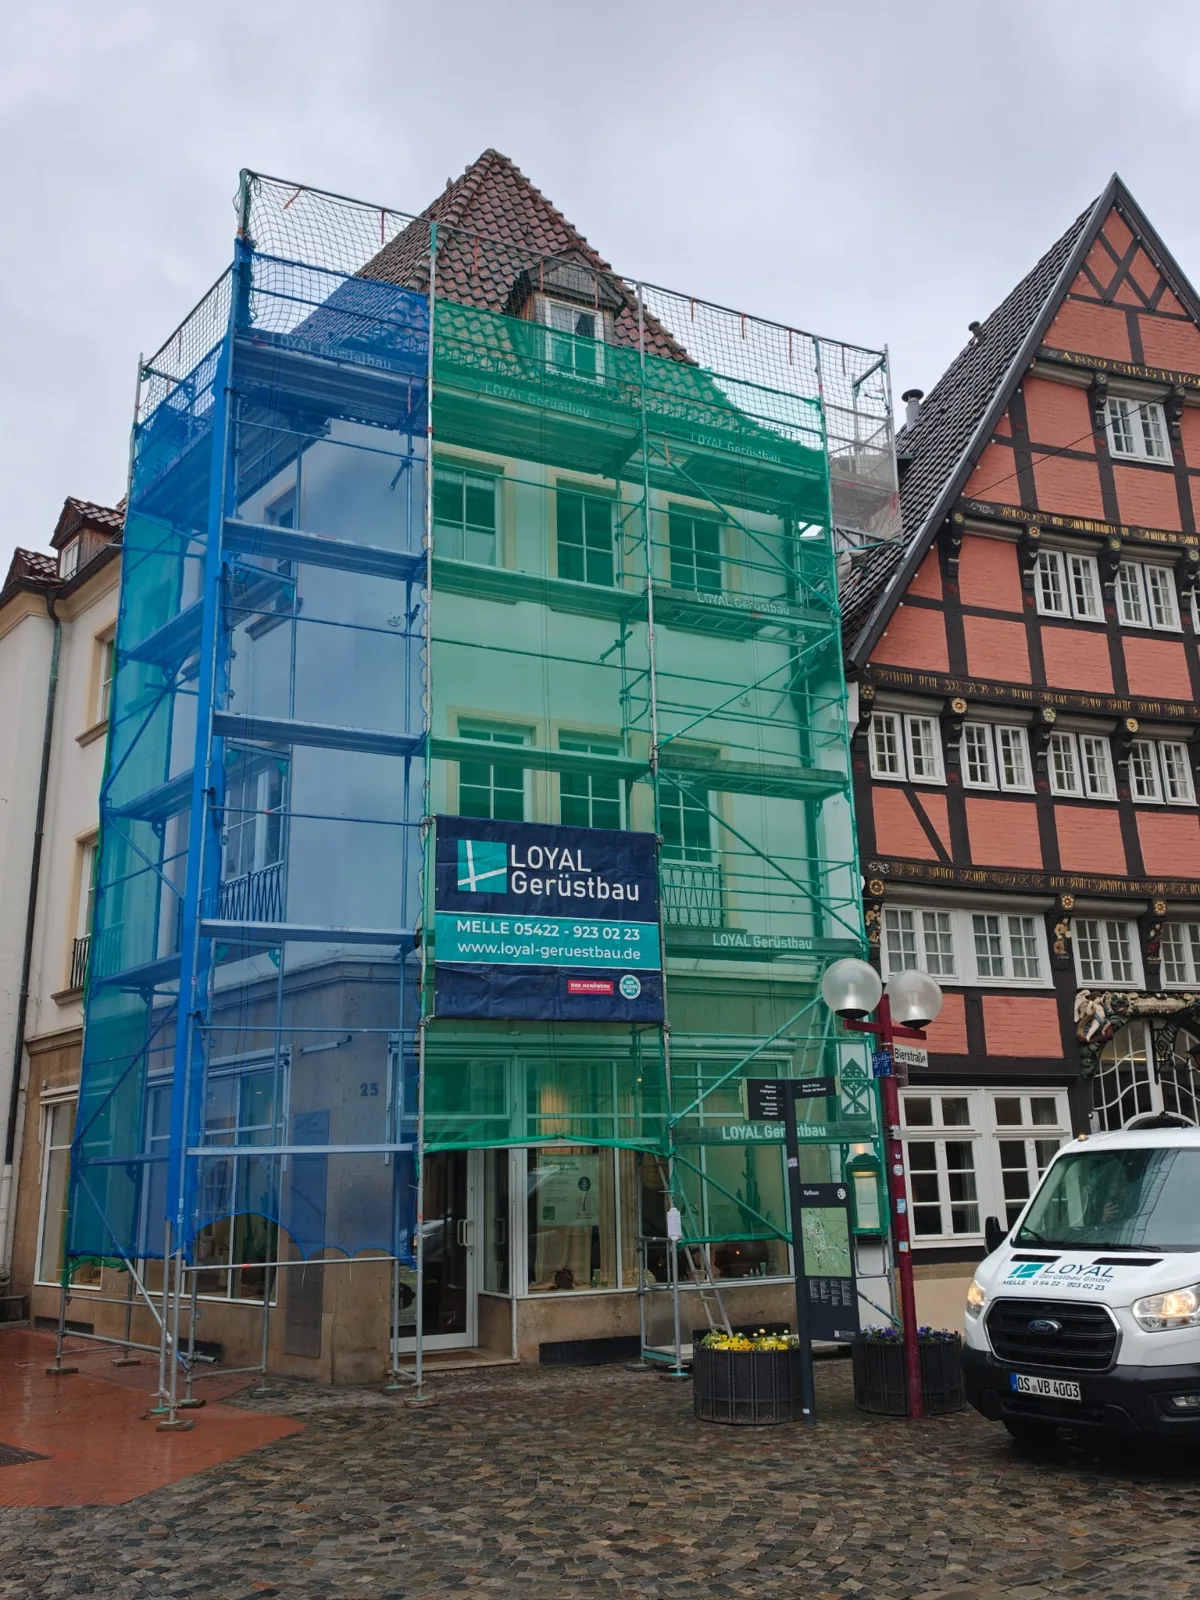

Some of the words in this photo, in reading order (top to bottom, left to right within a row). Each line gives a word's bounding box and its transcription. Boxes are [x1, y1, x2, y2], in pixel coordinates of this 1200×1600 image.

[271, 333, 313, 350] LOYAL
[485, 383, 523, 399] LOYAL
[691, 432, 722, 449] LOYAL
[697, 593, 733, 607] LOYAL
[511, 844, 592, 872] LOYAL
[511, 870, 639, 901] Gerüstbau
[456, 919, 509, 935] MELLE
[513, 922, 560, 937] 05422
[573, 925, 599, 939] 923
[602, 927, 620, 940] 02
[624, 928, 640, 941] 23
[712, 933, 751, 947] LOYAL
[753, 936, 813, 950] Gerüstbau
[457, 942, 641, 960] www.loyal-geruestbau.de
[894, 1047, 926, 1063] Bierstraße
[360, 1082, 379, 1097] 25
[722, 1125, 763, 1140] LOYAL
[764, 1124, 827, 1139] Gerstbau
[1044, 1263, 1114, 1278] LOYAL
[1083, 1275, 1112, 1283] GmbH
[1017, 1376, 1030, 1391] OS
[1037, 1379, 1051, 1394] VB
[1053, 1381, 1079, 1398] 4003
